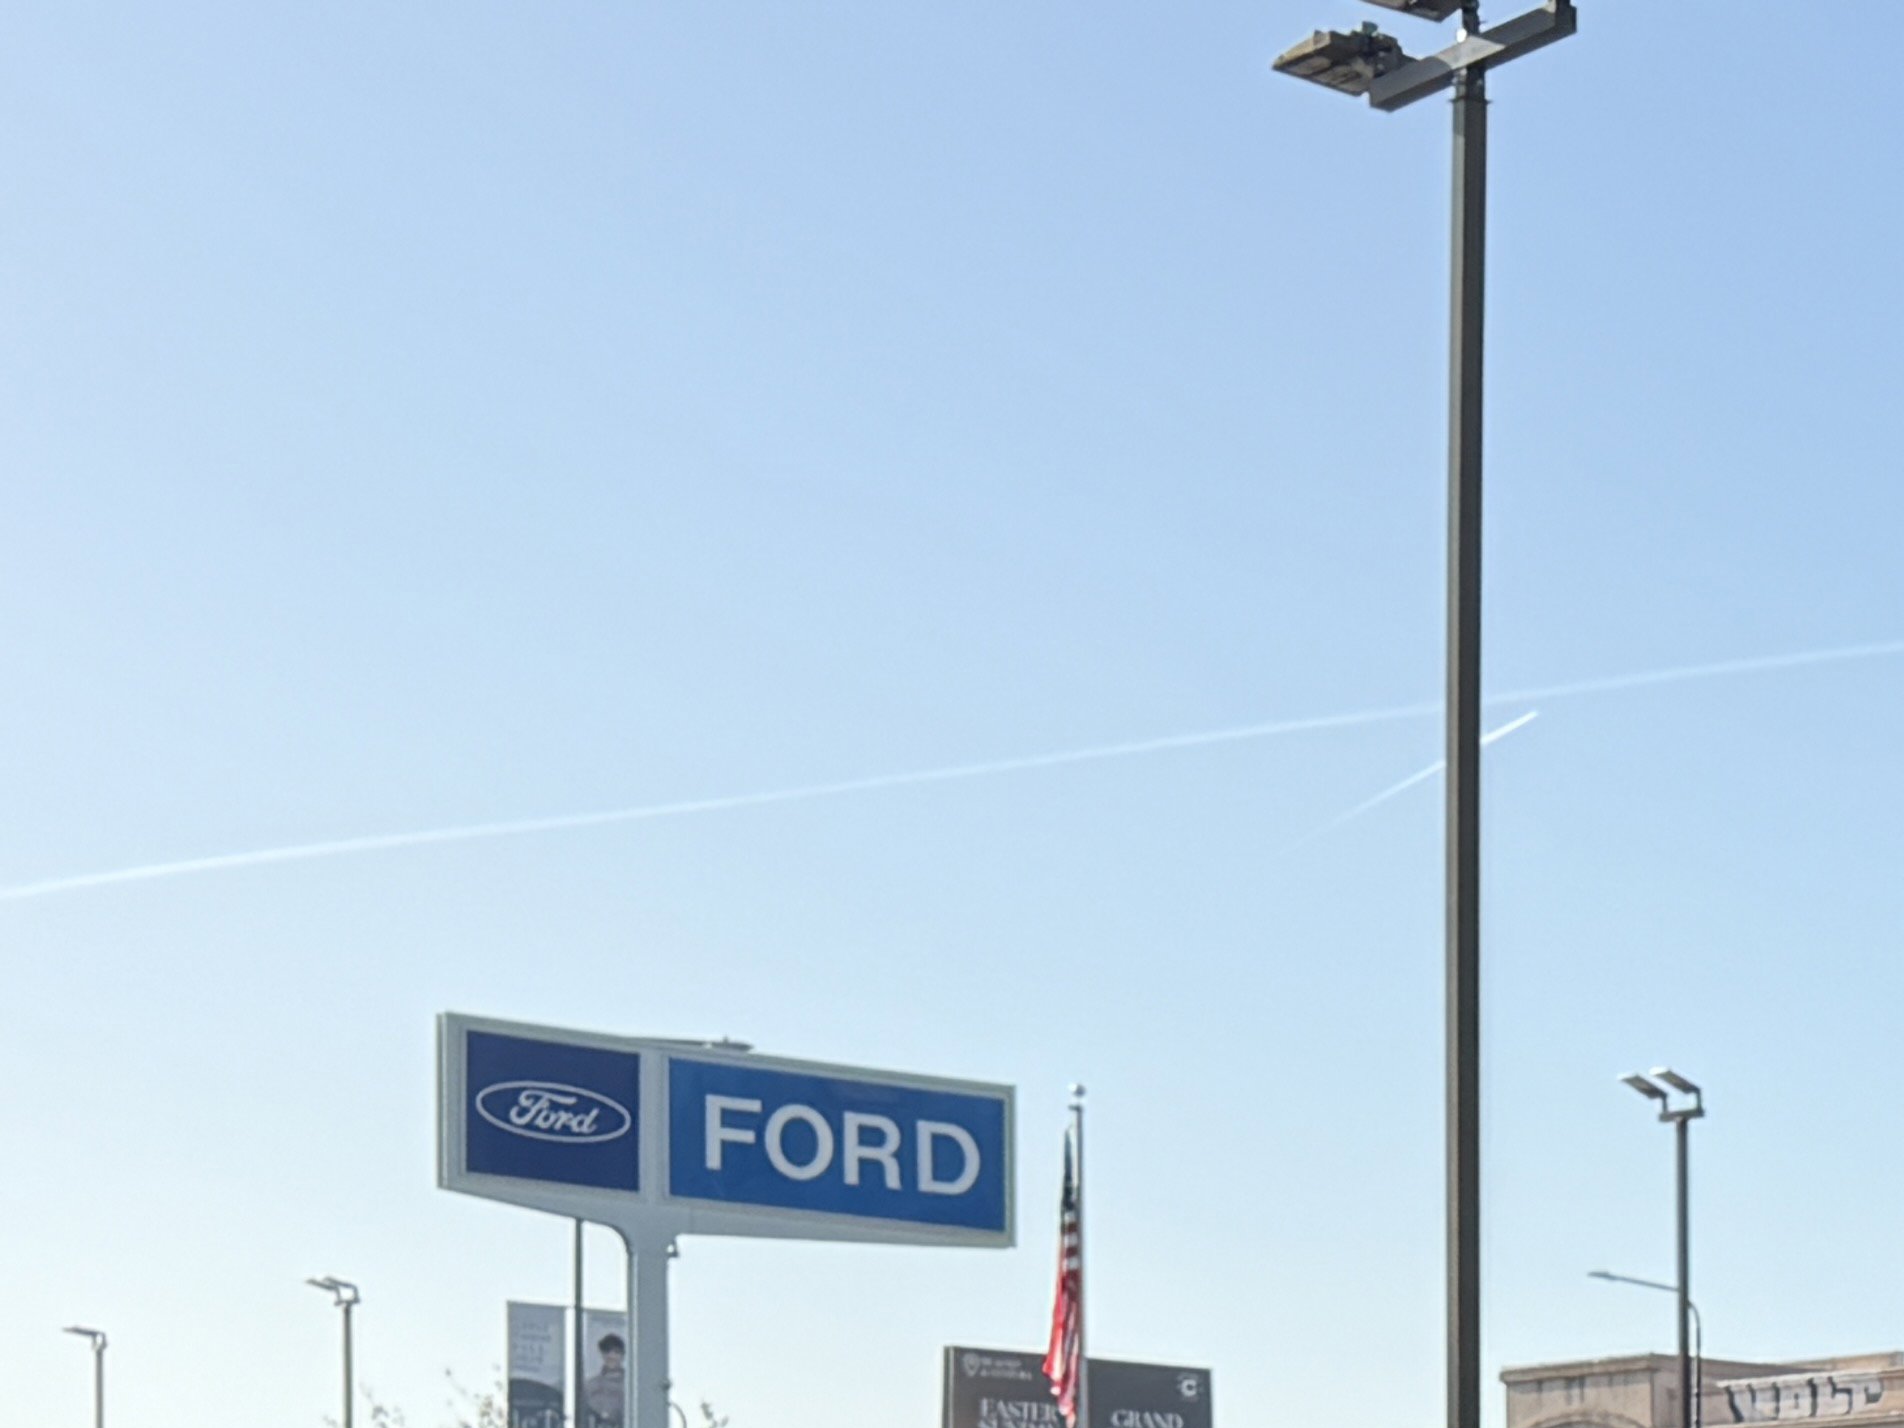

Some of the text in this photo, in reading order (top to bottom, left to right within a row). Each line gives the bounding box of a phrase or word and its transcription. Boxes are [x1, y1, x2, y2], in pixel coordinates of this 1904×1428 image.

[508, 1089, 599, 1136] Ford
[705, 1094, 982, 1196] FORD
[980, 1397, 1059, 1423] EASTER
